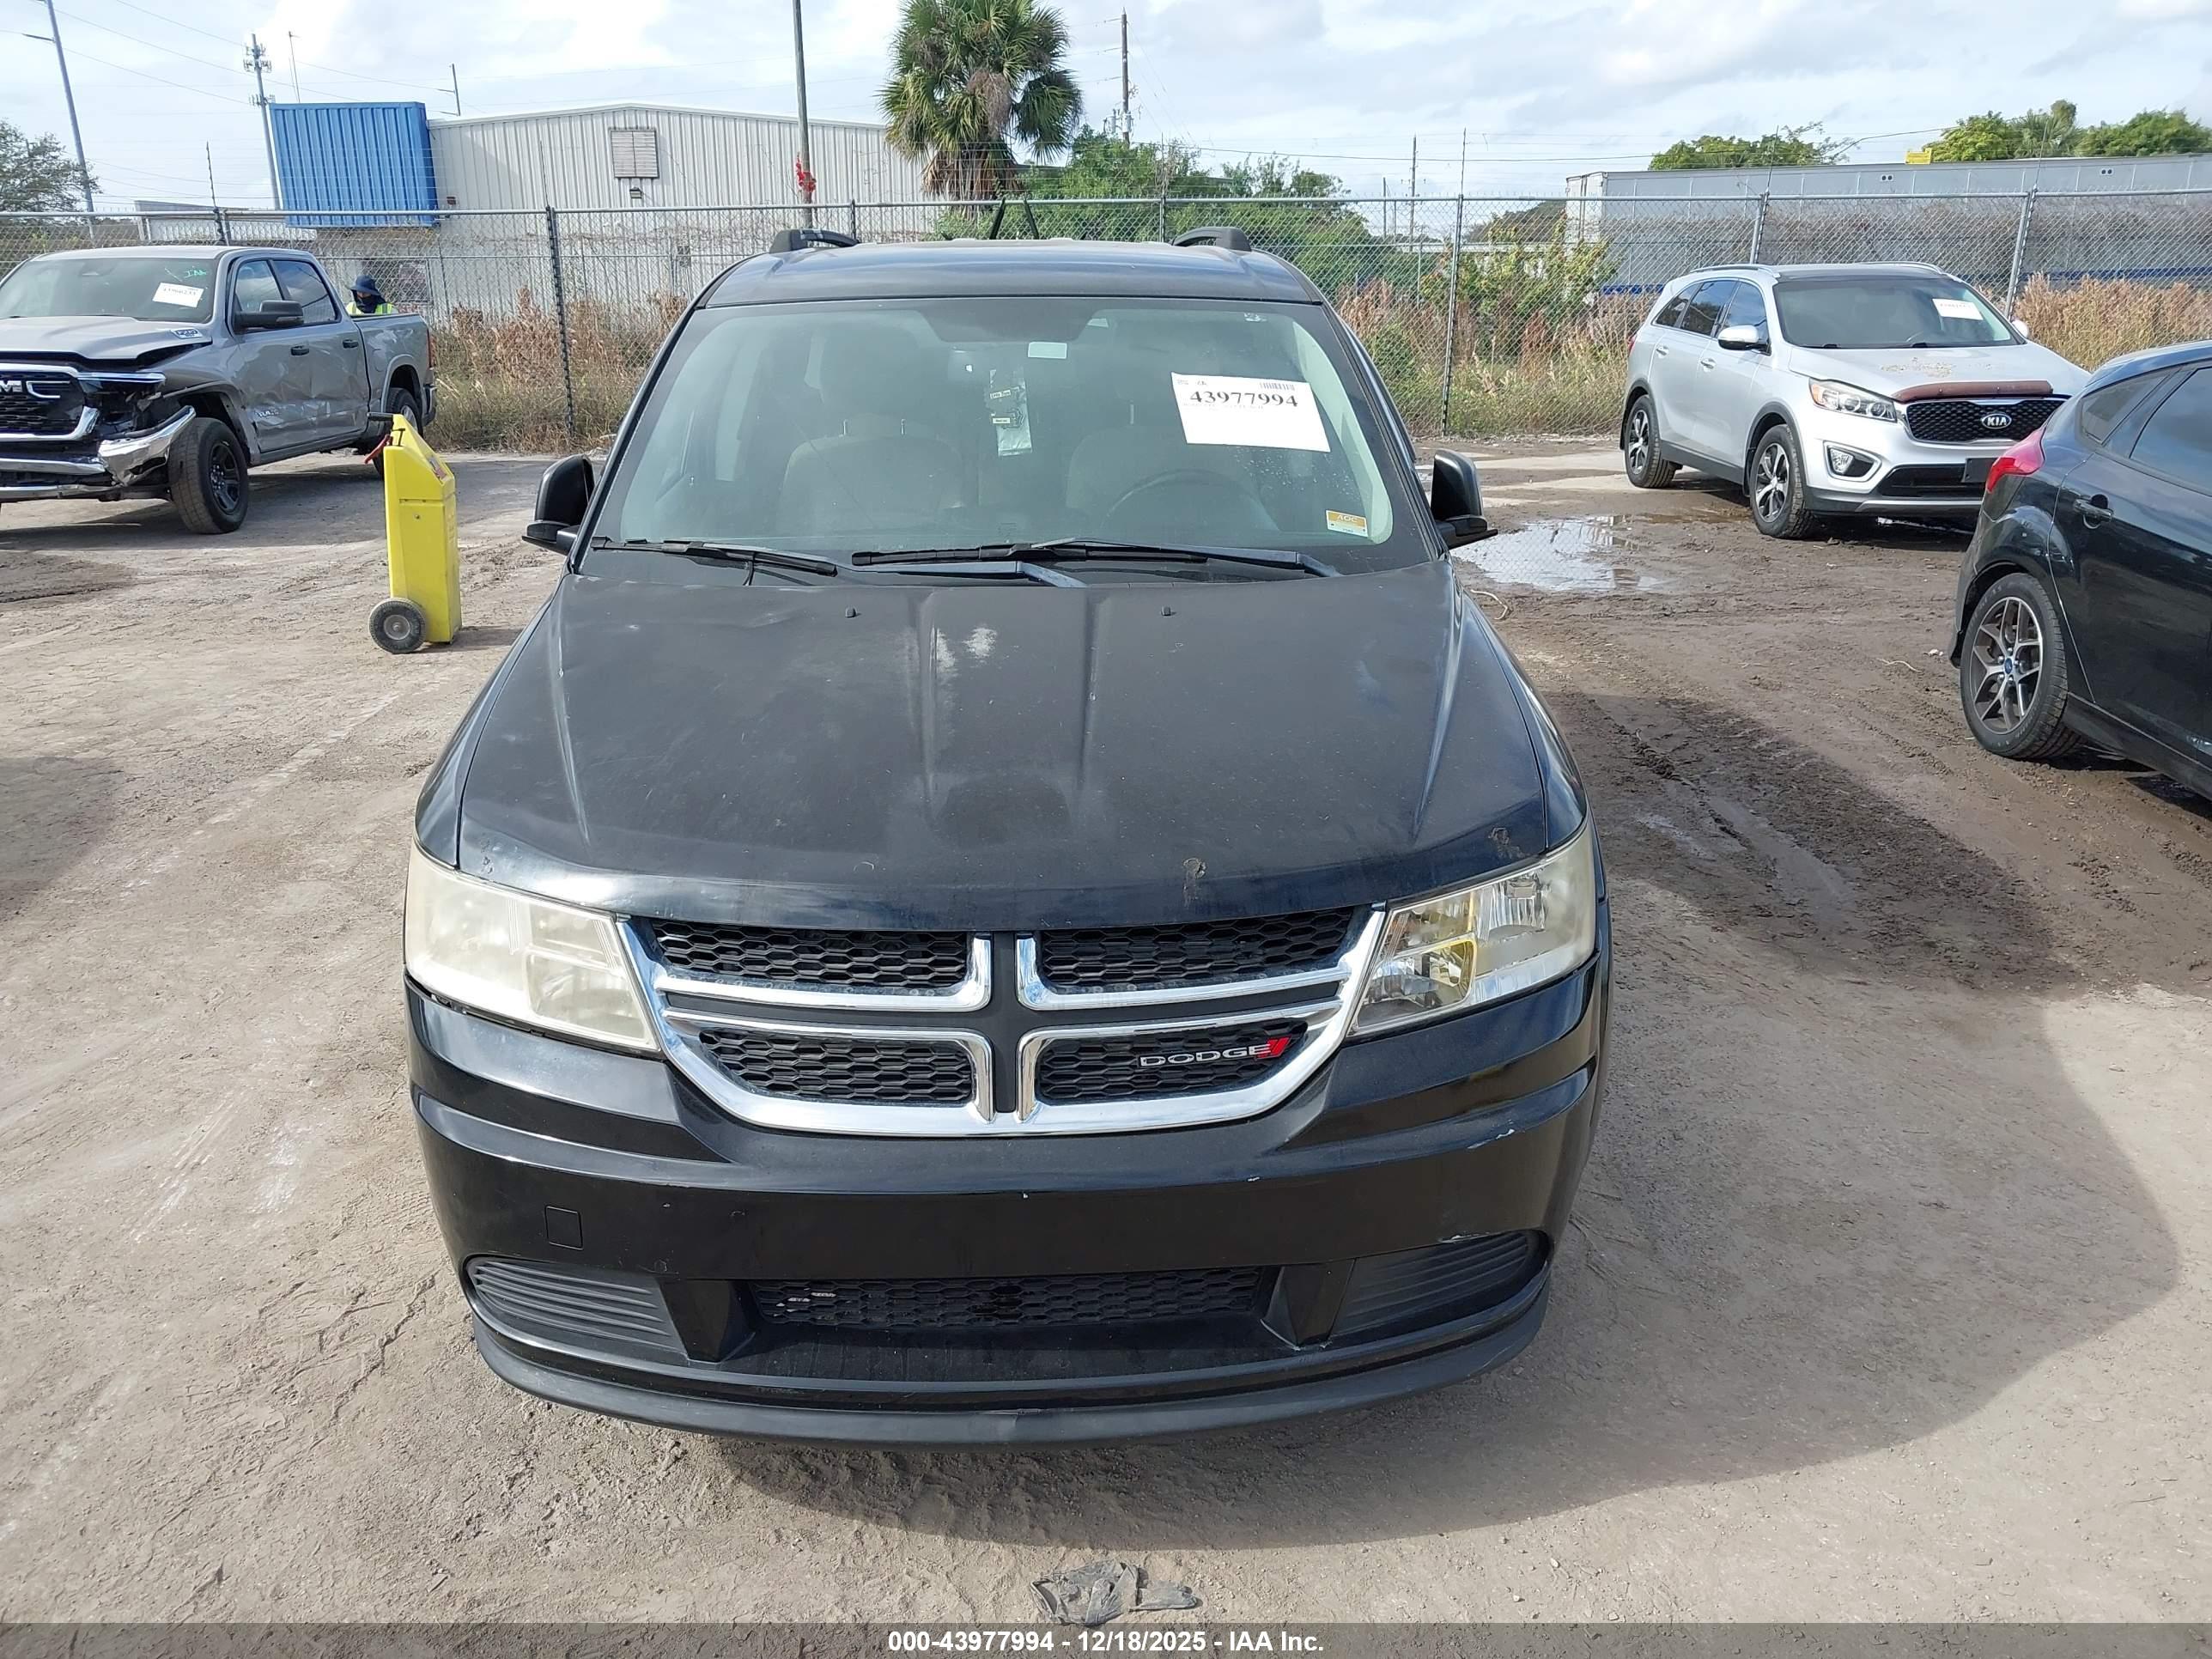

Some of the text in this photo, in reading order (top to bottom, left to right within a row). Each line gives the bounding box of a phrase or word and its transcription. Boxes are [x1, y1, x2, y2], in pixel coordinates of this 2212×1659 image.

[1190, 391, 1298, 407] 43977994
[1987, 416, 2007, 427] KIA
[1139, 1043, 1272, 1066] DODGE
